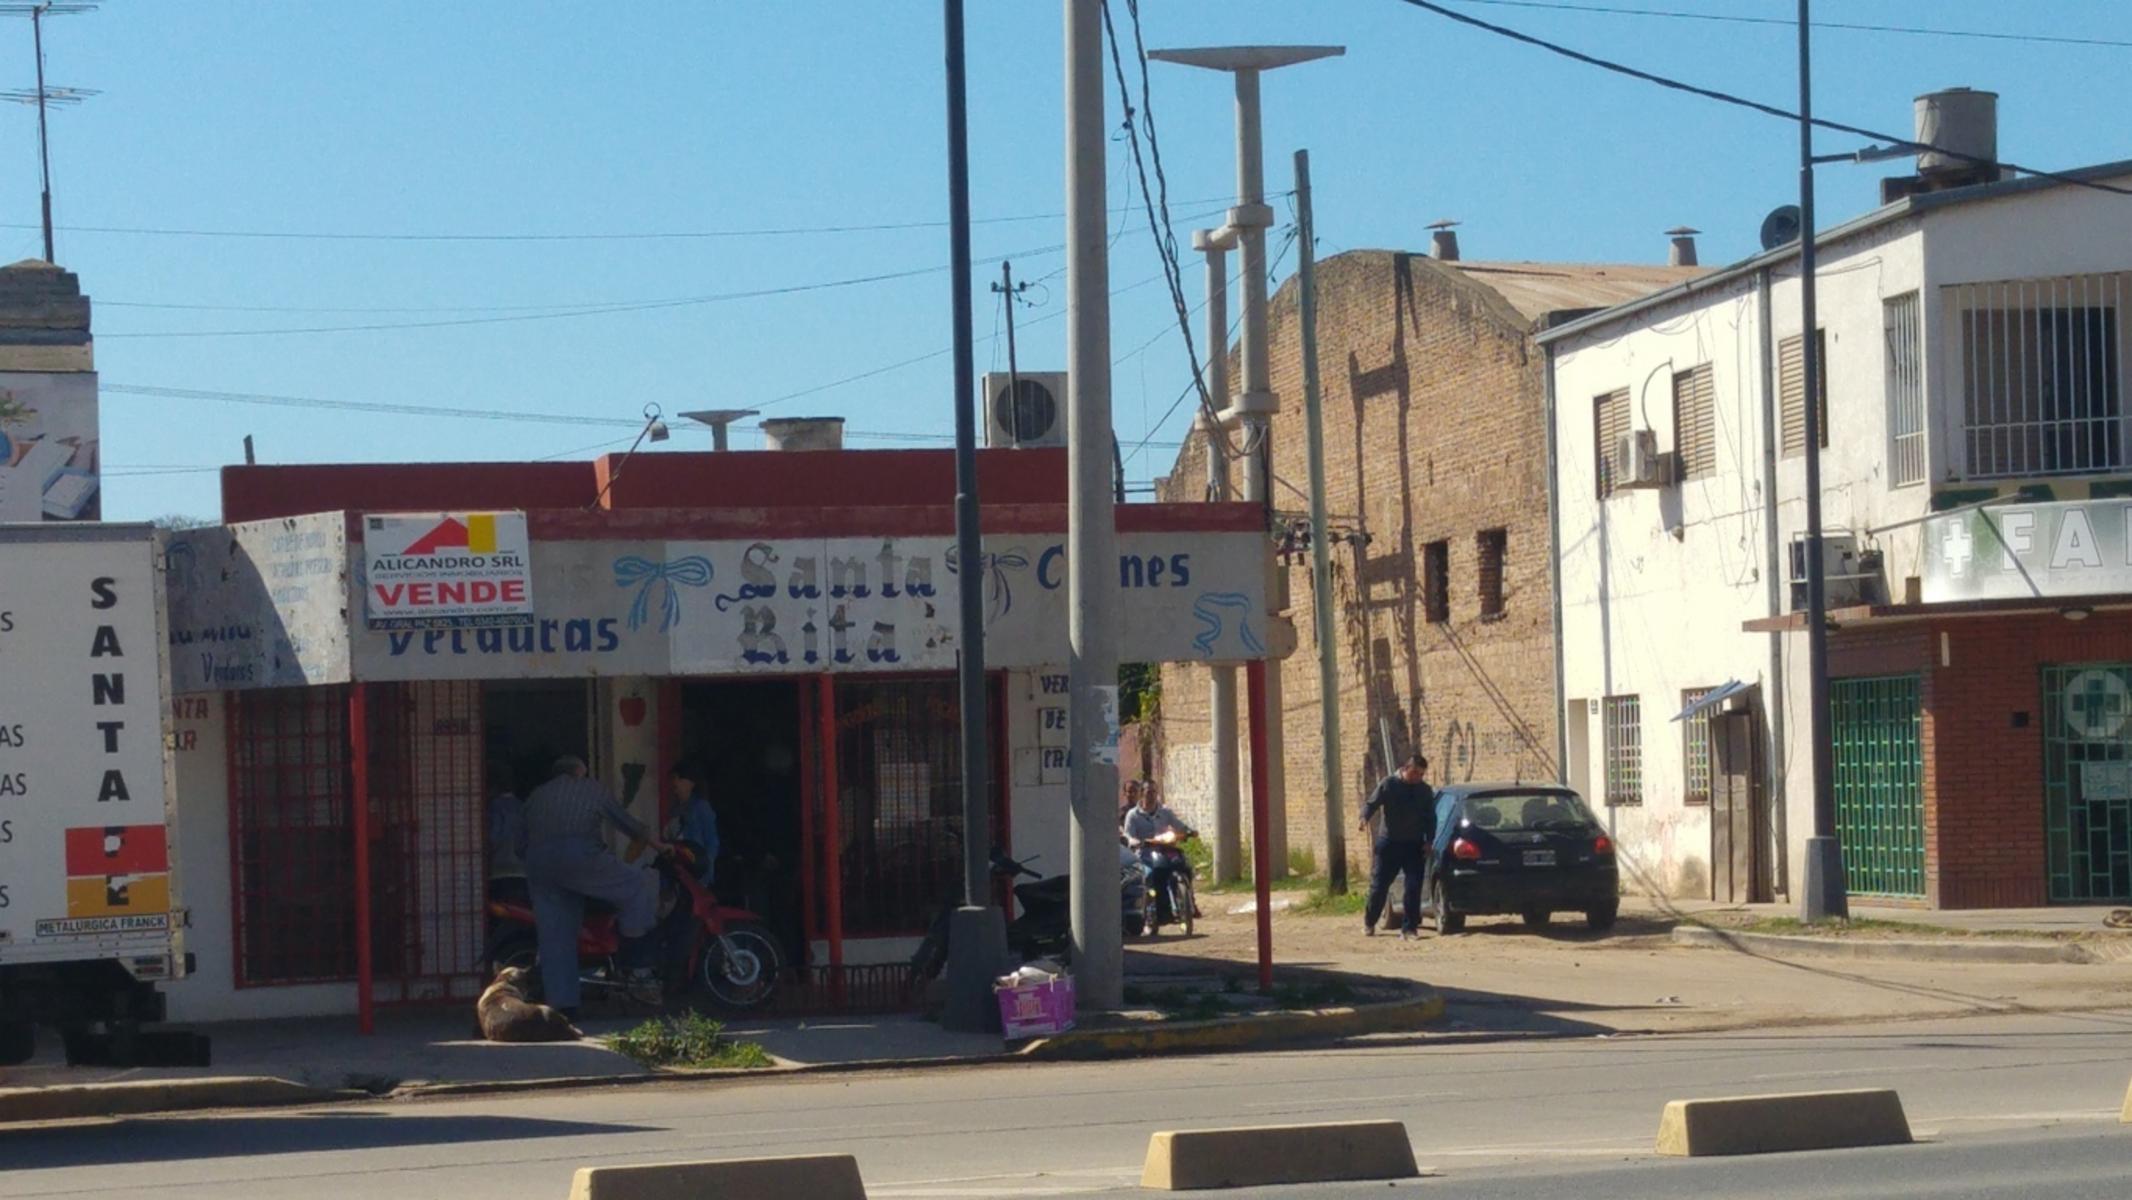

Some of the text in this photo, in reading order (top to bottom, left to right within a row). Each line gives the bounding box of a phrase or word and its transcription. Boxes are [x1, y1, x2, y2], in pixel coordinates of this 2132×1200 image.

[2001, 506, 2132, 571] FA
[373, 555, 524, 571] ALICANDRO SRL
[732, 538, 937, 600] Santa
[1037, 545, 1190, 589] Cnes
[374, 580, 526, 607] VENDE
[90, 576, 130, 802] SANTA
[0, 772, 27, 796] AS
[38, 916, 165, 934] METALURGICA FRANCK
